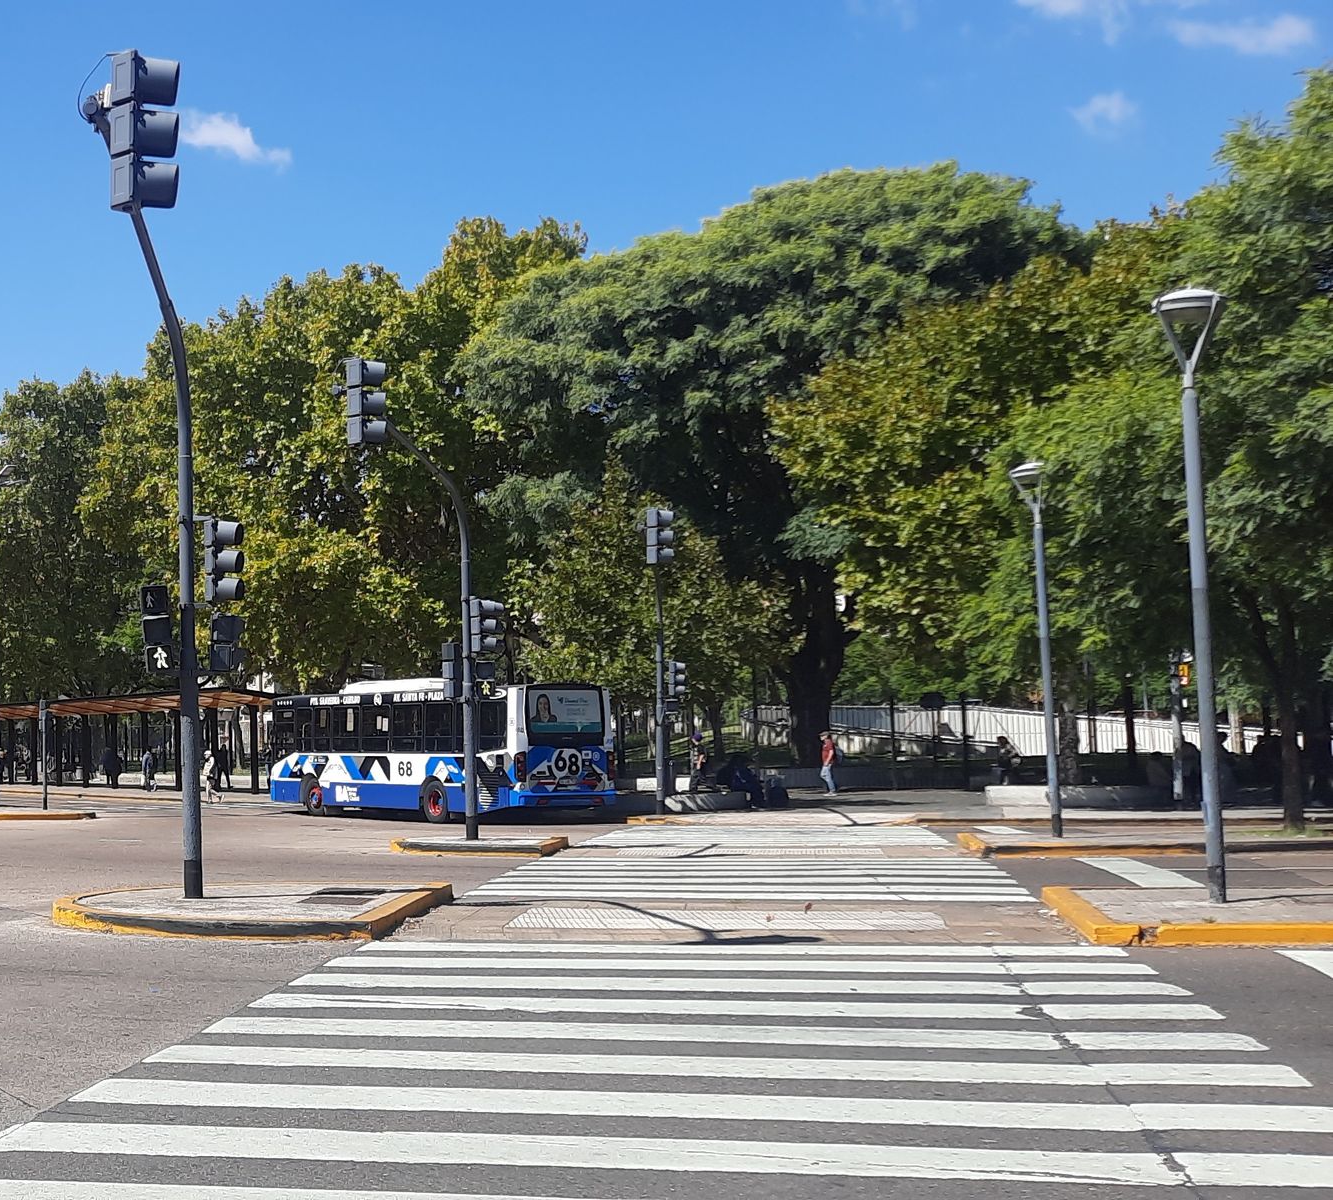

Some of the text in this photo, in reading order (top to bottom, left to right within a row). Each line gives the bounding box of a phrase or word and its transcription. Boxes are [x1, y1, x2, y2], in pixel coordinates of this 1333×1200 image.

[402, 692, 418, 702] SANTA
[427, 691, 444, 701] PLAZA
[398, 761, 413, 777] 68
[554, 750, 580, 776] 68
